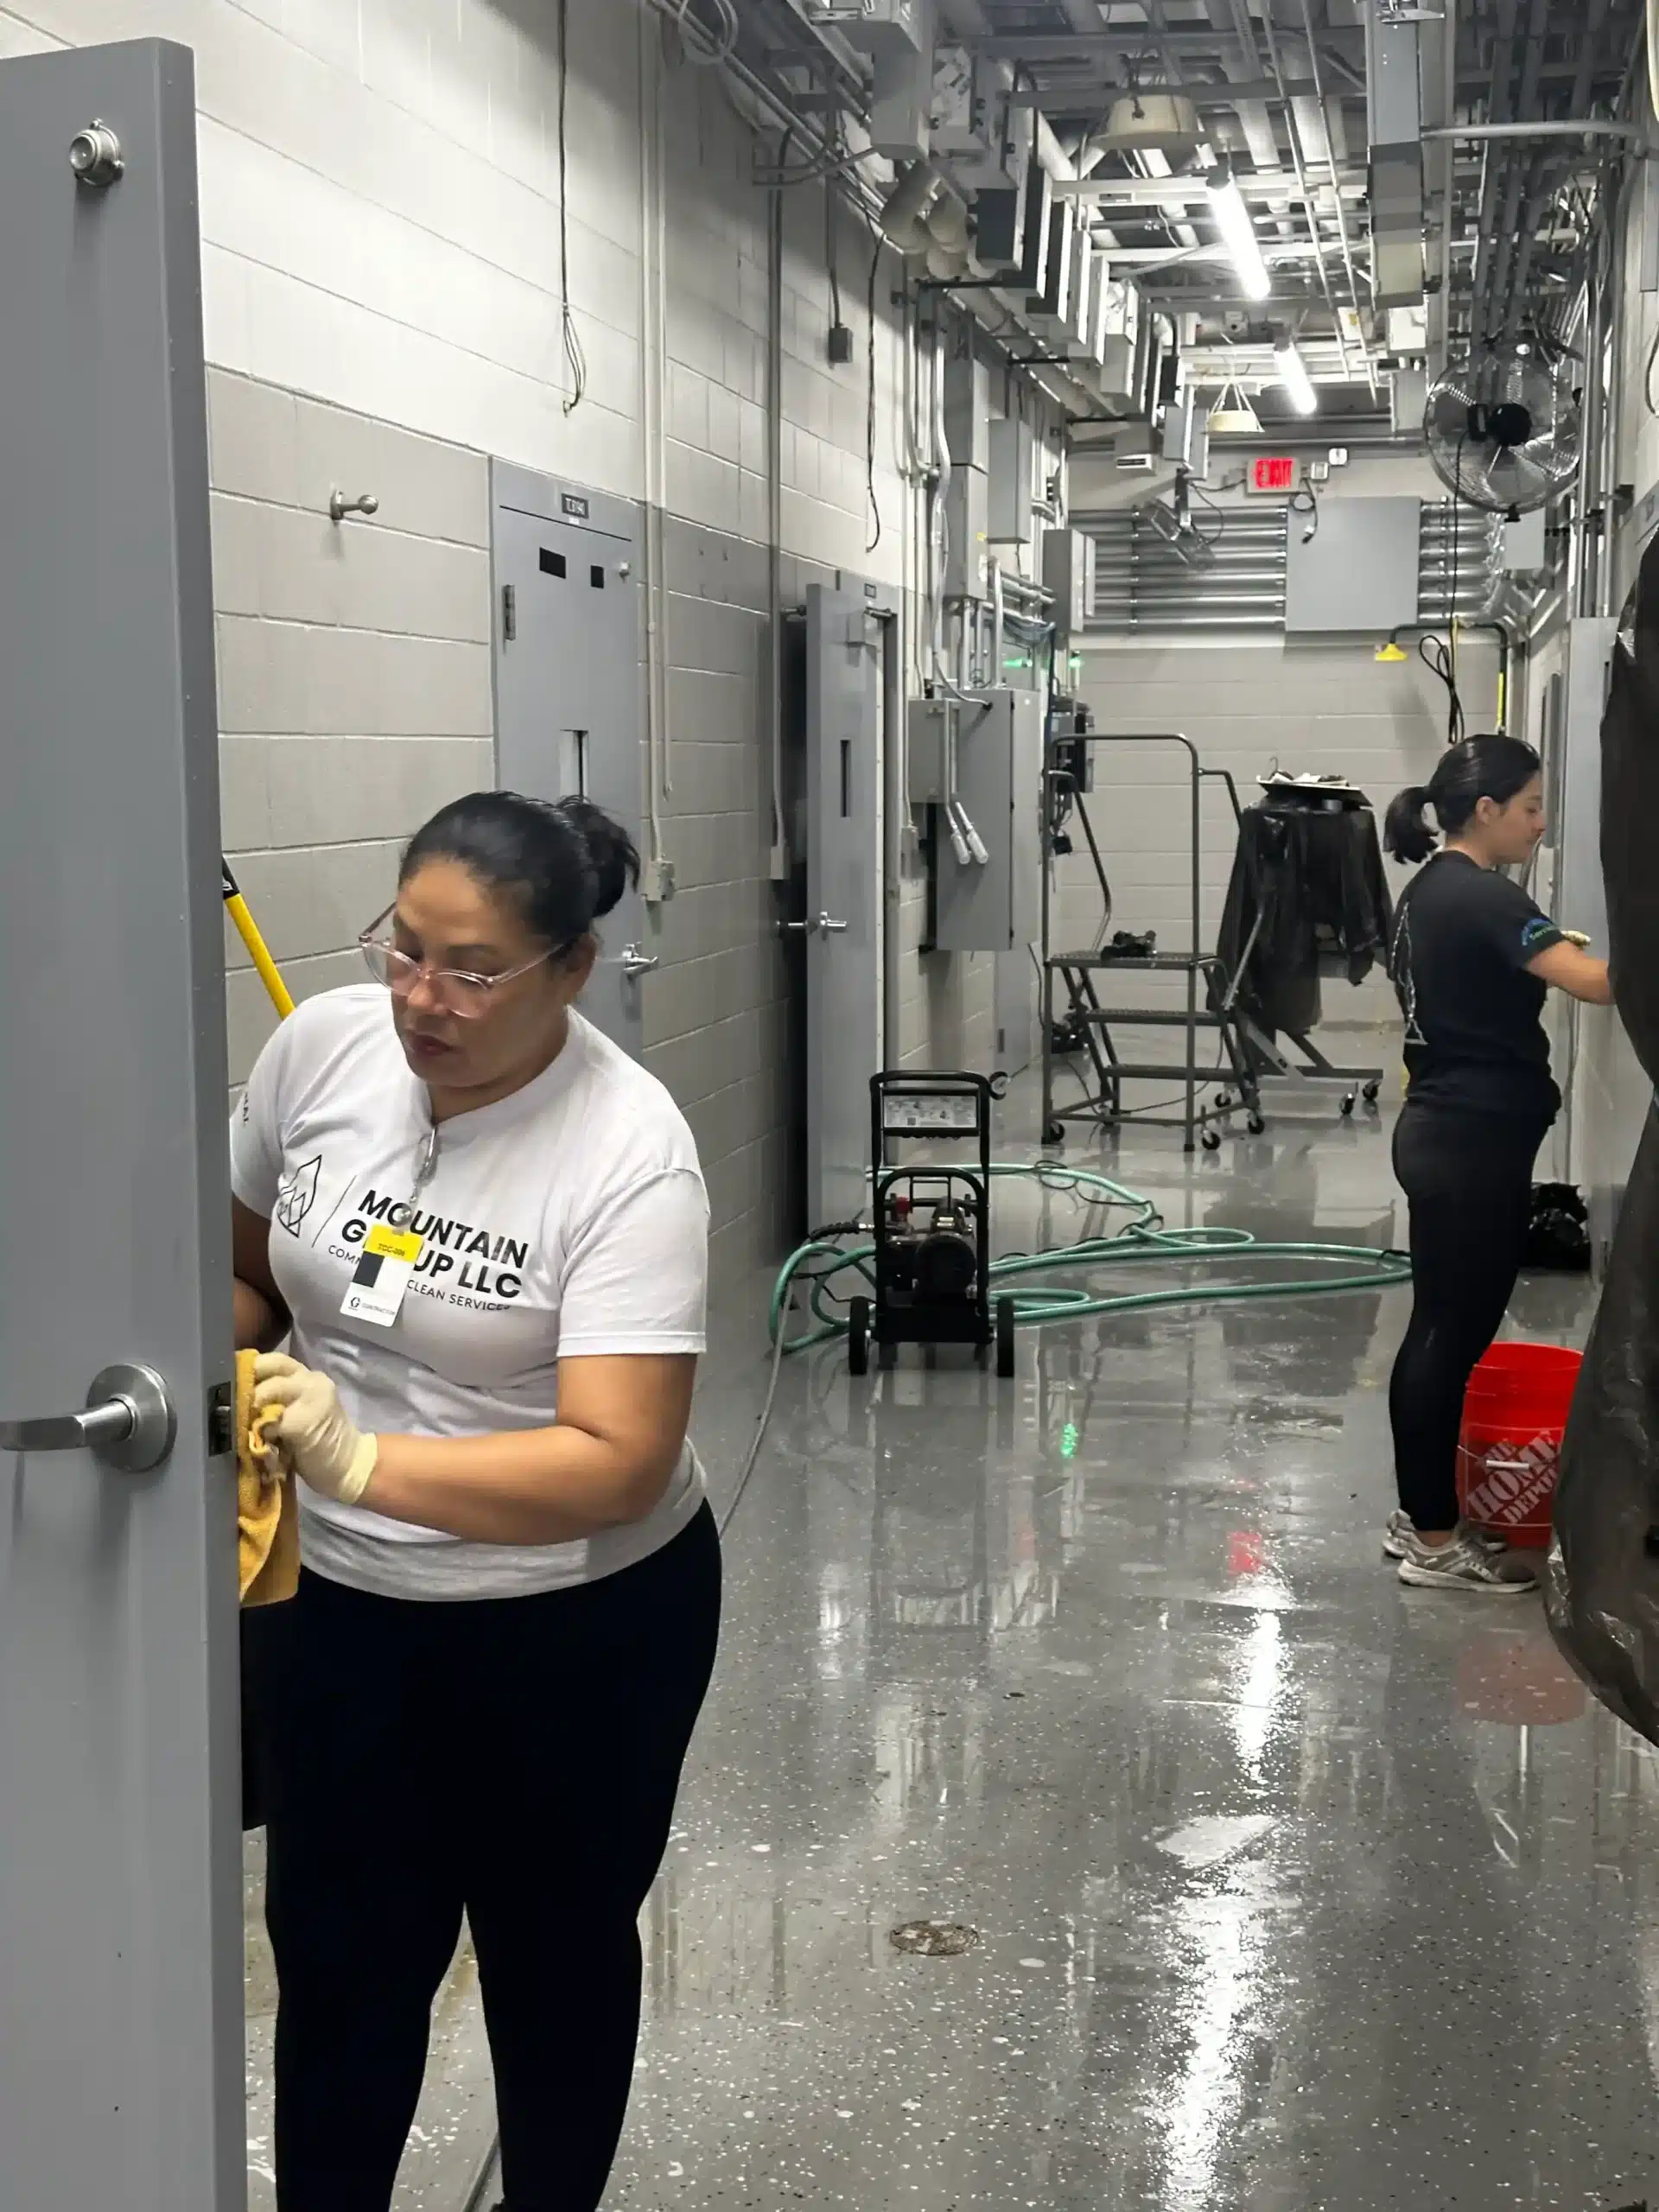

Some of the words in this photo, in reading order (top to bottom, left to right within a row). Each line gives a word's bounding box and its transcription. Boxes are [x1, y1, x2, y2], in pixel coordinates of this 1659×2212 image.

[341, 1219, 454, 1278] GUP
[457, 1261, 522, 1299] LLC
[358, 1189, 529, 1268] MOUNTAIN
[406, 1279, 446, 1300] CLEAN
